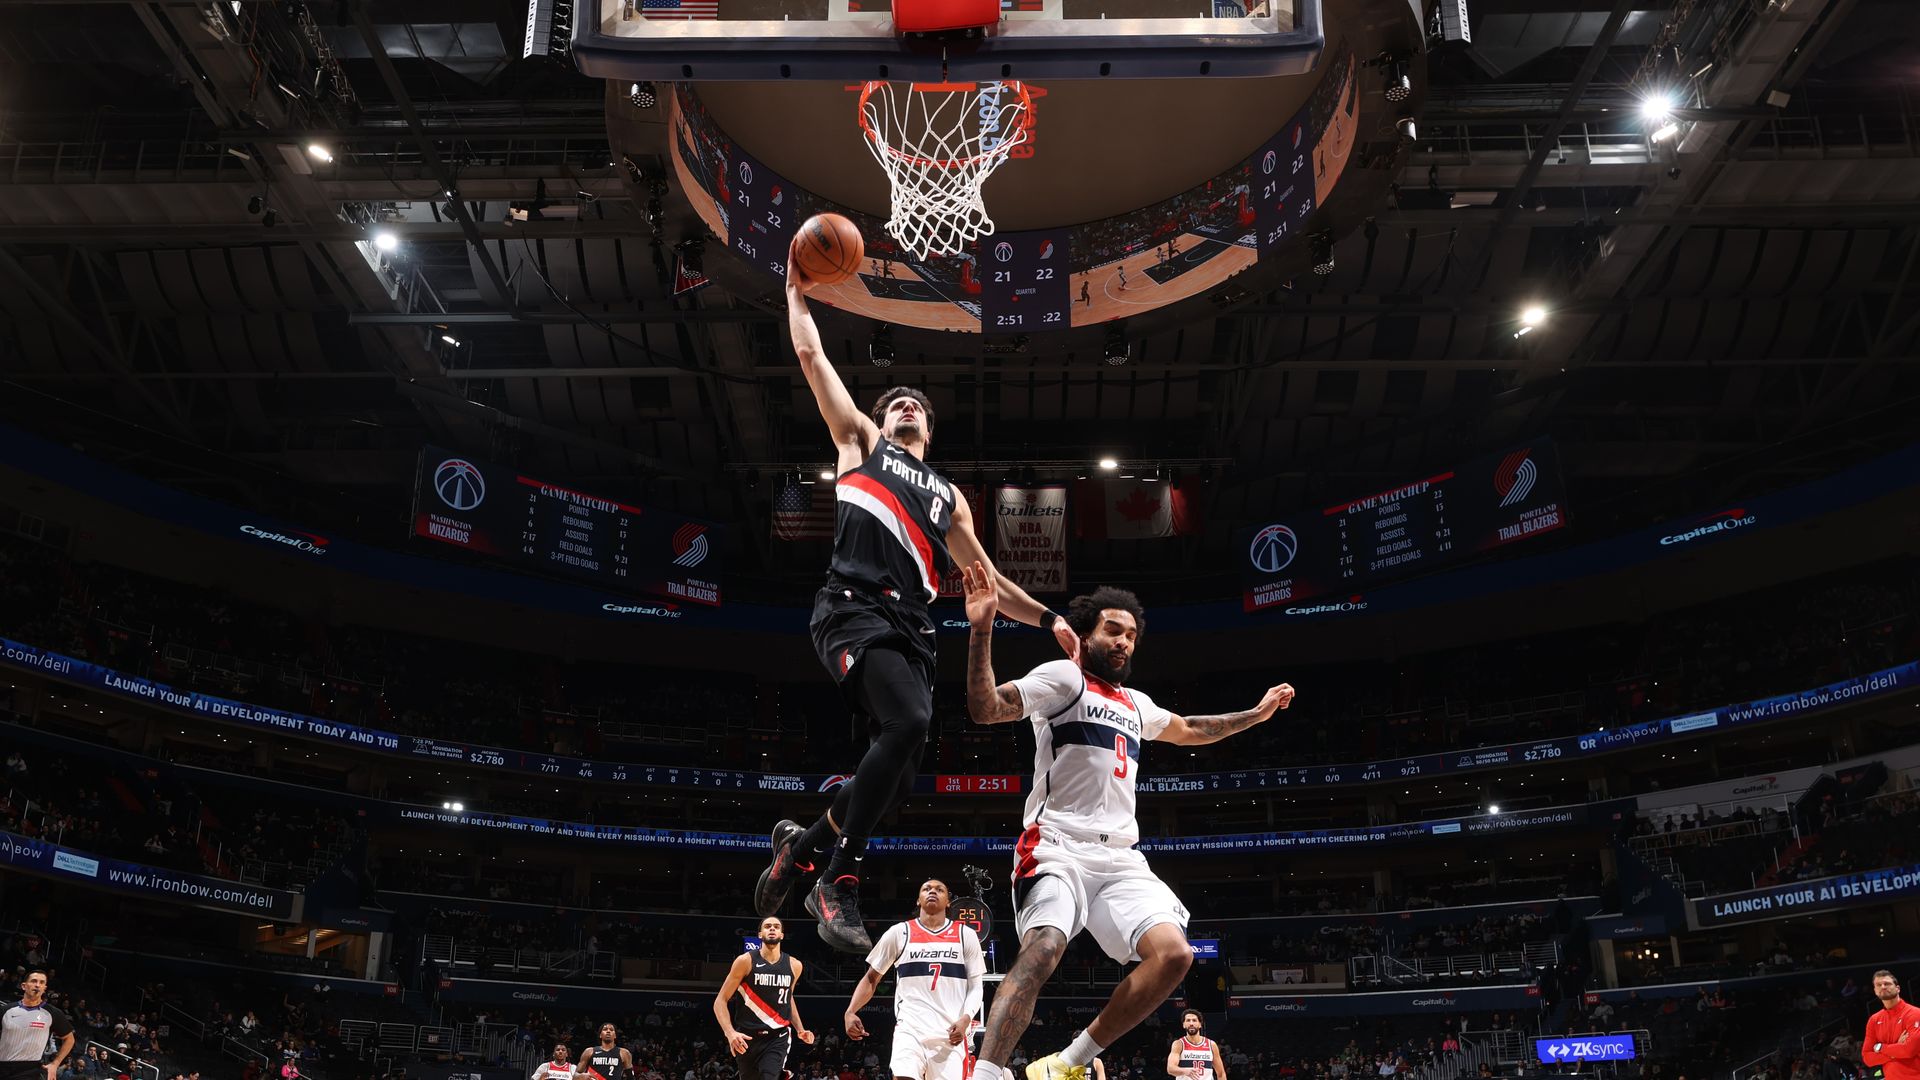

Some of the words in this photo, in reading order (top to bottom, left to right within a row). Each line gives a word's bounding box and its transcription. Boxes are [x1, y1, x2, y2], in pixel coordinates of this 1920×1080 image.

[1219, 6, 1239, 18] NBA
[1292, 154, 1304, 175] 22
[738, 190, 750, 208] 21
[1264, 180, 1276, 200] 21
[767, 211, 781, 229] 22
[1268, 220, 1288, 245] 2:51
[738, 237, 756, 259] 2:51
[994, 272, 1012, 284] 21
[1036, 268, 1054, 281] 22
[1015, 288, 1037, 296] QUARTER
[997, 314, 1024, 326] 2:51
[1042, 312, 1061, 324] :22
[881, 454, 951, 503] PORTLAND
[540, 485, 570, 503] GAME
[572, 493, 619, 515] MATCHUP
[1347, 496, 1377, 514] GAME
[1379, 481, 1430, 505] MATCHUP
[528, 494, 537, 503] 21
[568, 504, 590, 517] POINTS
[620, 518, 629, 527] 22
[929, 496, 943, 525] 8
[998, 504, 1063, 518] bullets
[1338, 518, 1347, 527] 21
[1378, 502, 1401, 516] POINTS
[1433, 489, 1443, 499] 22
[1519, 503, 1557, 521] PORTLAND
[430, 513, 473, 531] WASHINGTON
[528, 519, 533, 528] 6
[565, 529, 589, 542] ASSISTS
[562, 516, 594, 531] REBOUNDS
[1018, 522, 1042, 534] NBA
[1341, 531, 1347, 539] 8
[1375, 514, 1408, 530] REBOUNDS
[1497, 525, 1521, 541] TRAIL
[1522, 512, 1559, 535] BLAZERS
[428, 522, 469, 544] WIZARDS
[1342, 543, 1348, 552] 6
[1380, 527, 1406, 542] ASSISTS
[559, 540, 576, 552] FIELD
[576, 544, 593, 556] GOALS
[1010, 536, 1051, 549] WORLD
[1376, 542, 1393, 556] FIELD
[1394, 538, 1412, 552] GOALS
[550, 552, 565, 563] 3-PT
[565, 555, 581, 567] FIELD
[580, 558, 599, 571] GOALS
[998, 549, 1064, 562] CHAMPIONS
[1370, 559, 1385, 572] 3-PT
[1385, 555, 1402, 569] FIELD
[1402, 550, 1422, 565] GOALS
[666, 581, 687, 598] TRAIL
[687, 584, 718, 603] BLAZERS
[686, 577, 718, 591] PORTLAND
[1253, 578, 1293, 594] WASHINGTON
[1253, 588, 1292, 606] WIZARDS
[104, 673, 156, 698] LAUNCH
[159, 689, 191, 708] YOUR
[194, 698, 209, 711] AI
[212, 702, 305, 731] DEVELOPMENT
[307, 722, 347, 739] TODAY
[349, 729, 375, 744] AND
[376, 735, 399, 749] TUR
[1087, 704, 1139, 736] wizards
[1579, 739, 1597, 750] OR
[1729, 673, 1898, 723] www.ironbow.com/dell
[470, 753, 504, 766] $2,780
[1114, 733, 1128, 779] 9
[1475, 751, 1508, 760] FOUNDATION
[1492, 756, 1509, 764] RAFFLE
[1524, 747, 1562, 761] $2,780
[540, 763, 560, 774] 7/17
[578, 768, 593, 778] 4/6
[612, 771, 627, 781] 3/3
[647, 774, 653, 782] 6
[670, 775, 676, 783] 8
[693, 777, 699, 785] 2
[715, 778, 721, 786] 0
[736, 779, 742, 788] 6
[763, 774, 801, 782] WASHINGTON
[945, 784, 961, 792] QTR
[978, 777, 1008, 790] 2:51
[947, 777, 960, 785] 1st
[1212, 781, 1219, 789] 6
[1235, 780, 1241, 788] 3
[1259, 778, 1265, 786] 4
[1277, 777, 1288, 785] 14
[1300, 776, 1306, 784] 4
[1325, 774, 1340, 783] 0/0
[1361, 770, 1381, 780] 4/11
[1400, 766, 1421, 776] 9/21
[758, 779, 806, 791] WIZARDS
[1135, 781, 1156, 792] RAIL
[1158, 780, 1204, 792] BLAZERS
[400, 810, 435, 821] LAUNCH
[436, 813, 458, 824] YOUR
[460, 816, 469, 825] AI
[471, 818, 528, 831] DEVELOPMENT
[530, 824, 556, 834] TODAY
[557, 827, 574, 836] AND
[575, 829, 596, 838] TURN
[597, 831, 623, 841] EVERY
[624, 833, 656, 843] MISSION
[657, 835, 675, 844] INTO
[677, 836, 683, 844] A
[685, 836, 717, 846] MOMENT
[719, 839, 745, 848] WORTH
[1154, 842, 1173, 850] TURN
[1175, 841, 1201, 850] EVERY
[1202, 840, 1234, 849] MISSION
[1235, 839, 1253, 848] INTO
[1255, 839, 1262, 847] A
[1263, 837, 1296, 847] MOMENT
[1298, 836, 1326, 845] WORTH
[1328, 833, 1367, 844] CHEERING
[1369, 832, 1386, 841] FOR
[1468, 812, 1573, 832] www.ironbow.com/dell
[875, 842, 967, 853] www.ironbow.com/dell
[109, 868, 274, 909] www.ironbow.com/dell
[1714, 895, 1772, 917] LAUNCH
[1775, 890, 1815, 908] YOUR
[1820, 887, 1837, 901] AI
[959, 908, 985, 920] 2:51
[909, 949, 960, 960] wizards
[754, 973, 792, 988] PORTLAND
[928, 963, 942, 991] 7
[777, 988, 790, 1005] 21
[1571, 1041, 1625, 1059] ZKsync
[592, 1057, 619, 1066] PORTLAND
[608, 1065, 615, 1077] 2
